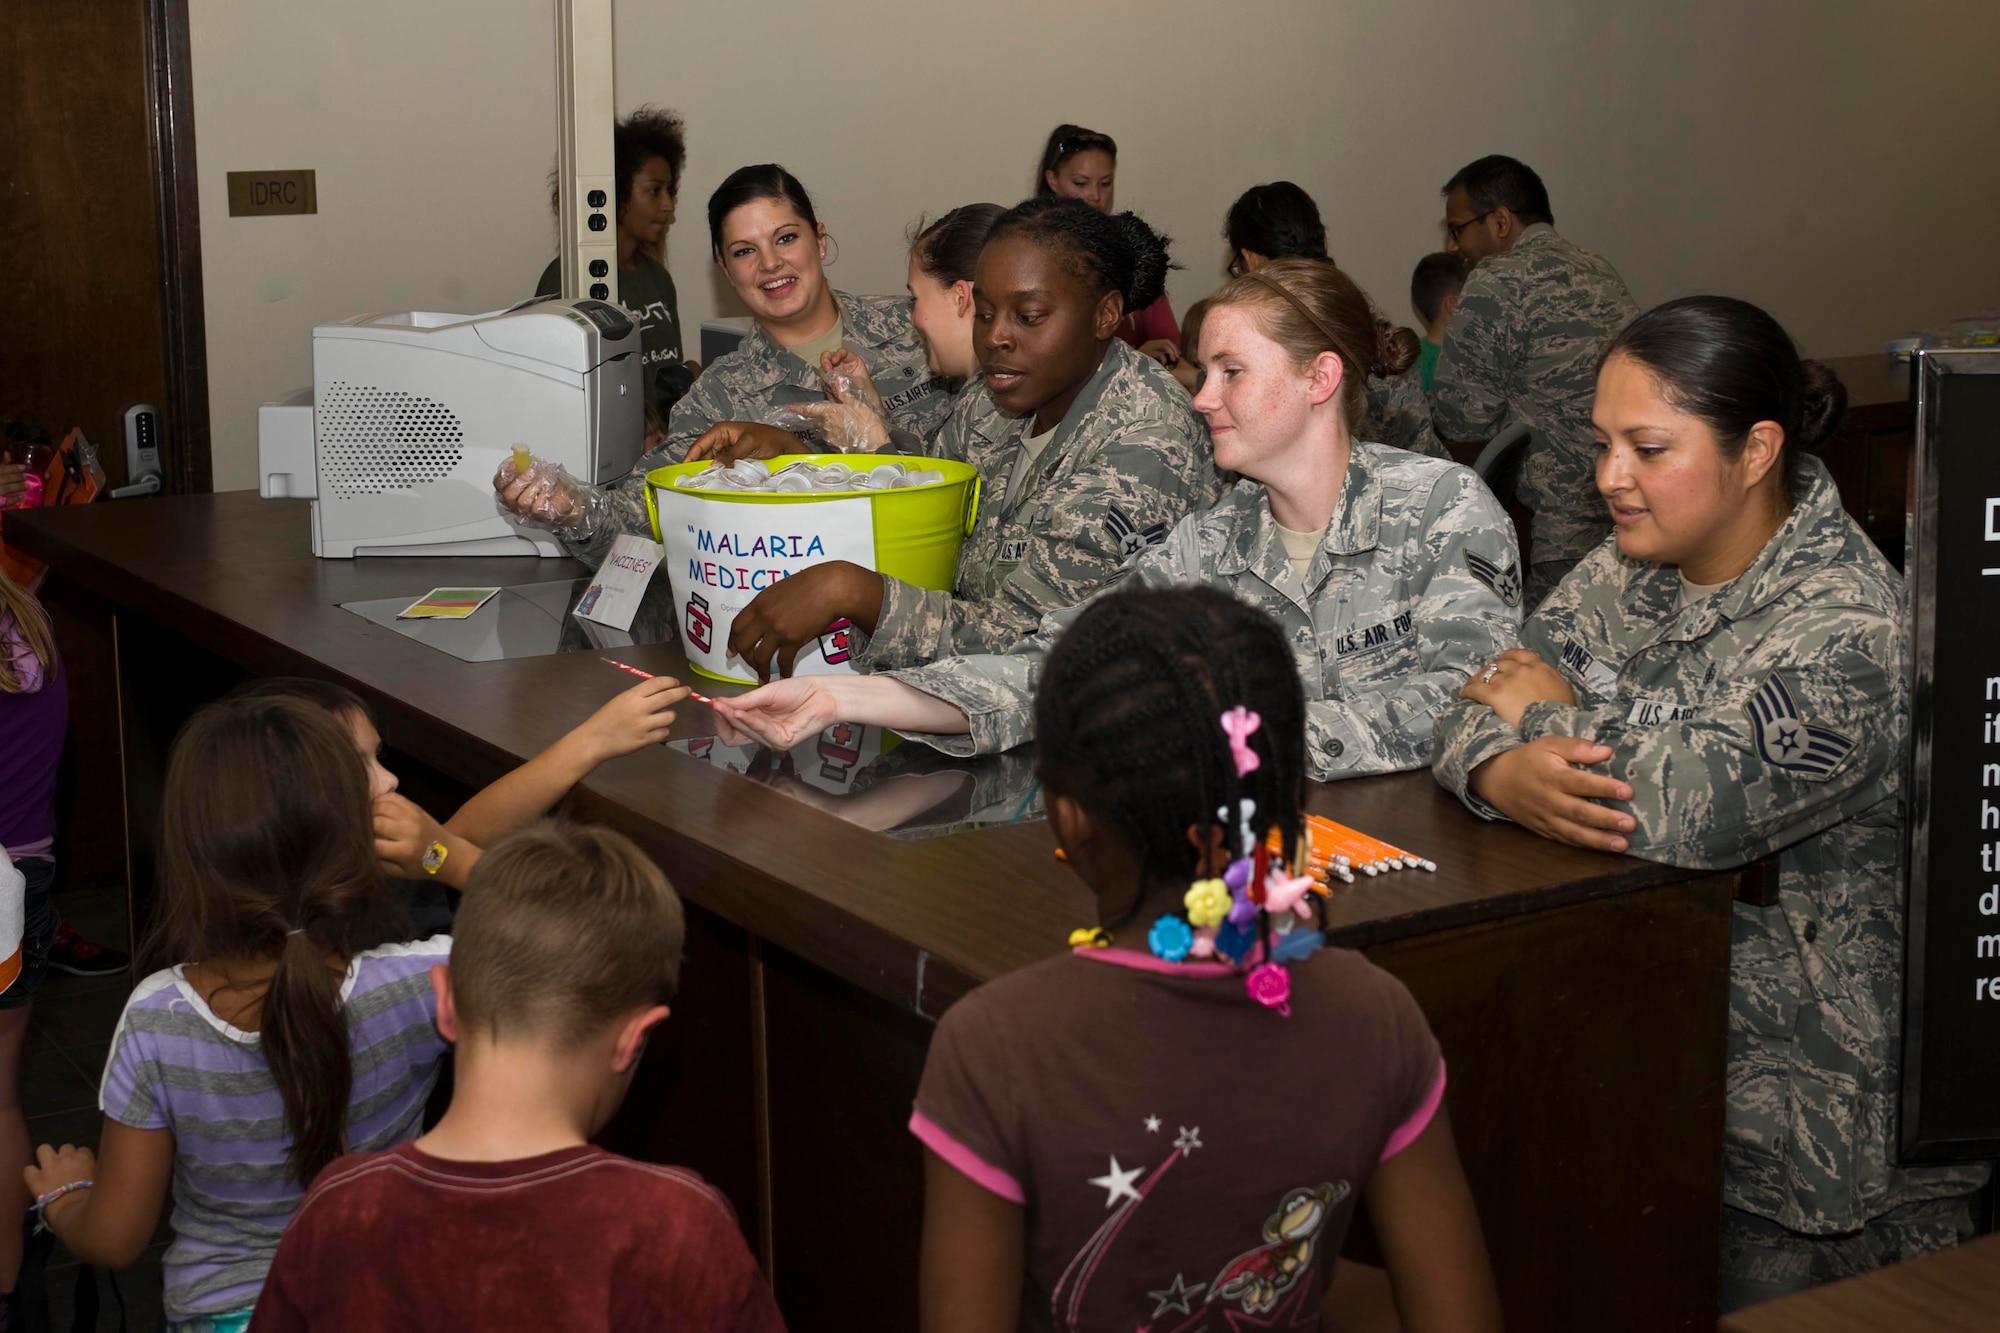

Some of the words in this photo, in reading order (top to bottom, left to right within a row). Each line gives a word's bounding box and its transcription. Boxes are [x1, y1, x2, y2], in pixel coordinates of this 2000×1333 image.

[250, 180, 297, 206] IDRC
[905, 386, 922, 402] AIR
[1337, 634, 1358, 654] U.S.
[1364, 624, 1389, 648] AIR
